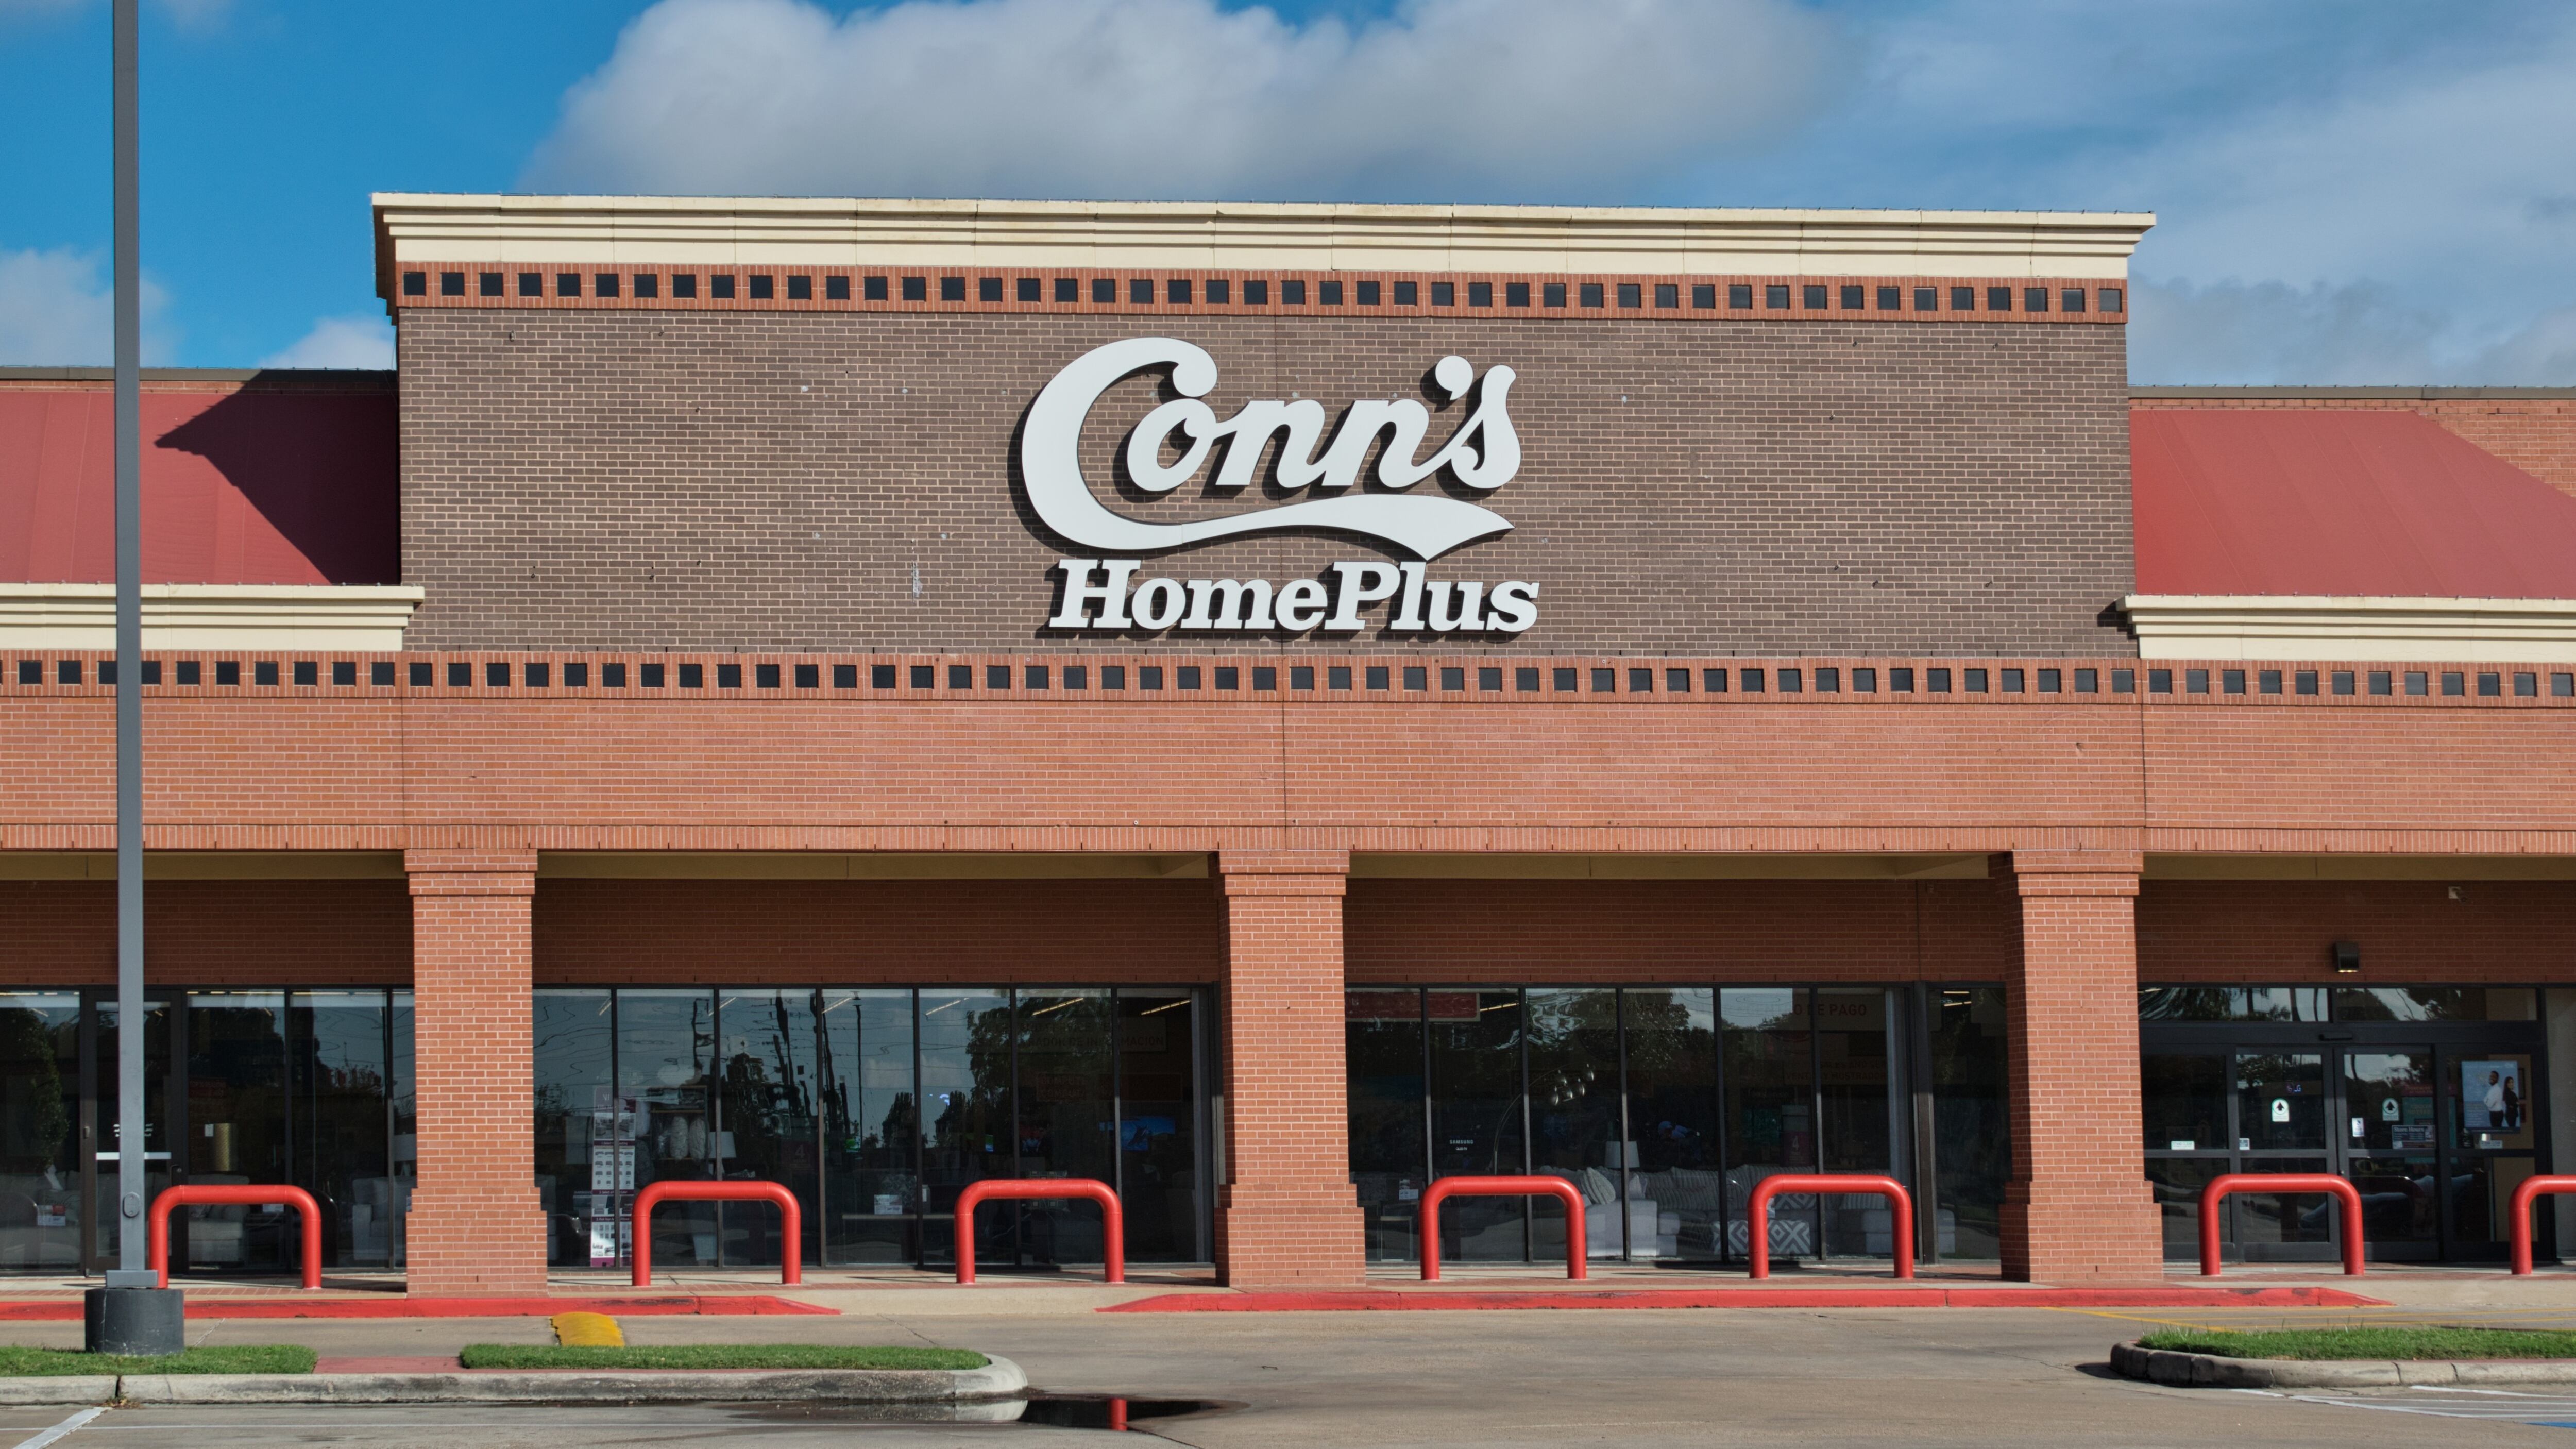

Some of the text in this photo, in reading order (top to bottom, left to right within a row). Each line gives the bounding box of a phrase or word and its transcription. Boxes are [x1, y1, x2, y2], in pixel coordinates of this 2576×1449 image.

[1022, 336, 1521, 550] Conn's
[1049, 559, 1540, 632] HomePlus
[1829, 1004, 1867, 1016] PAGO
[795, 1144, 805, 1158] 4
[1792, 1135, 1799, 1151] 4
